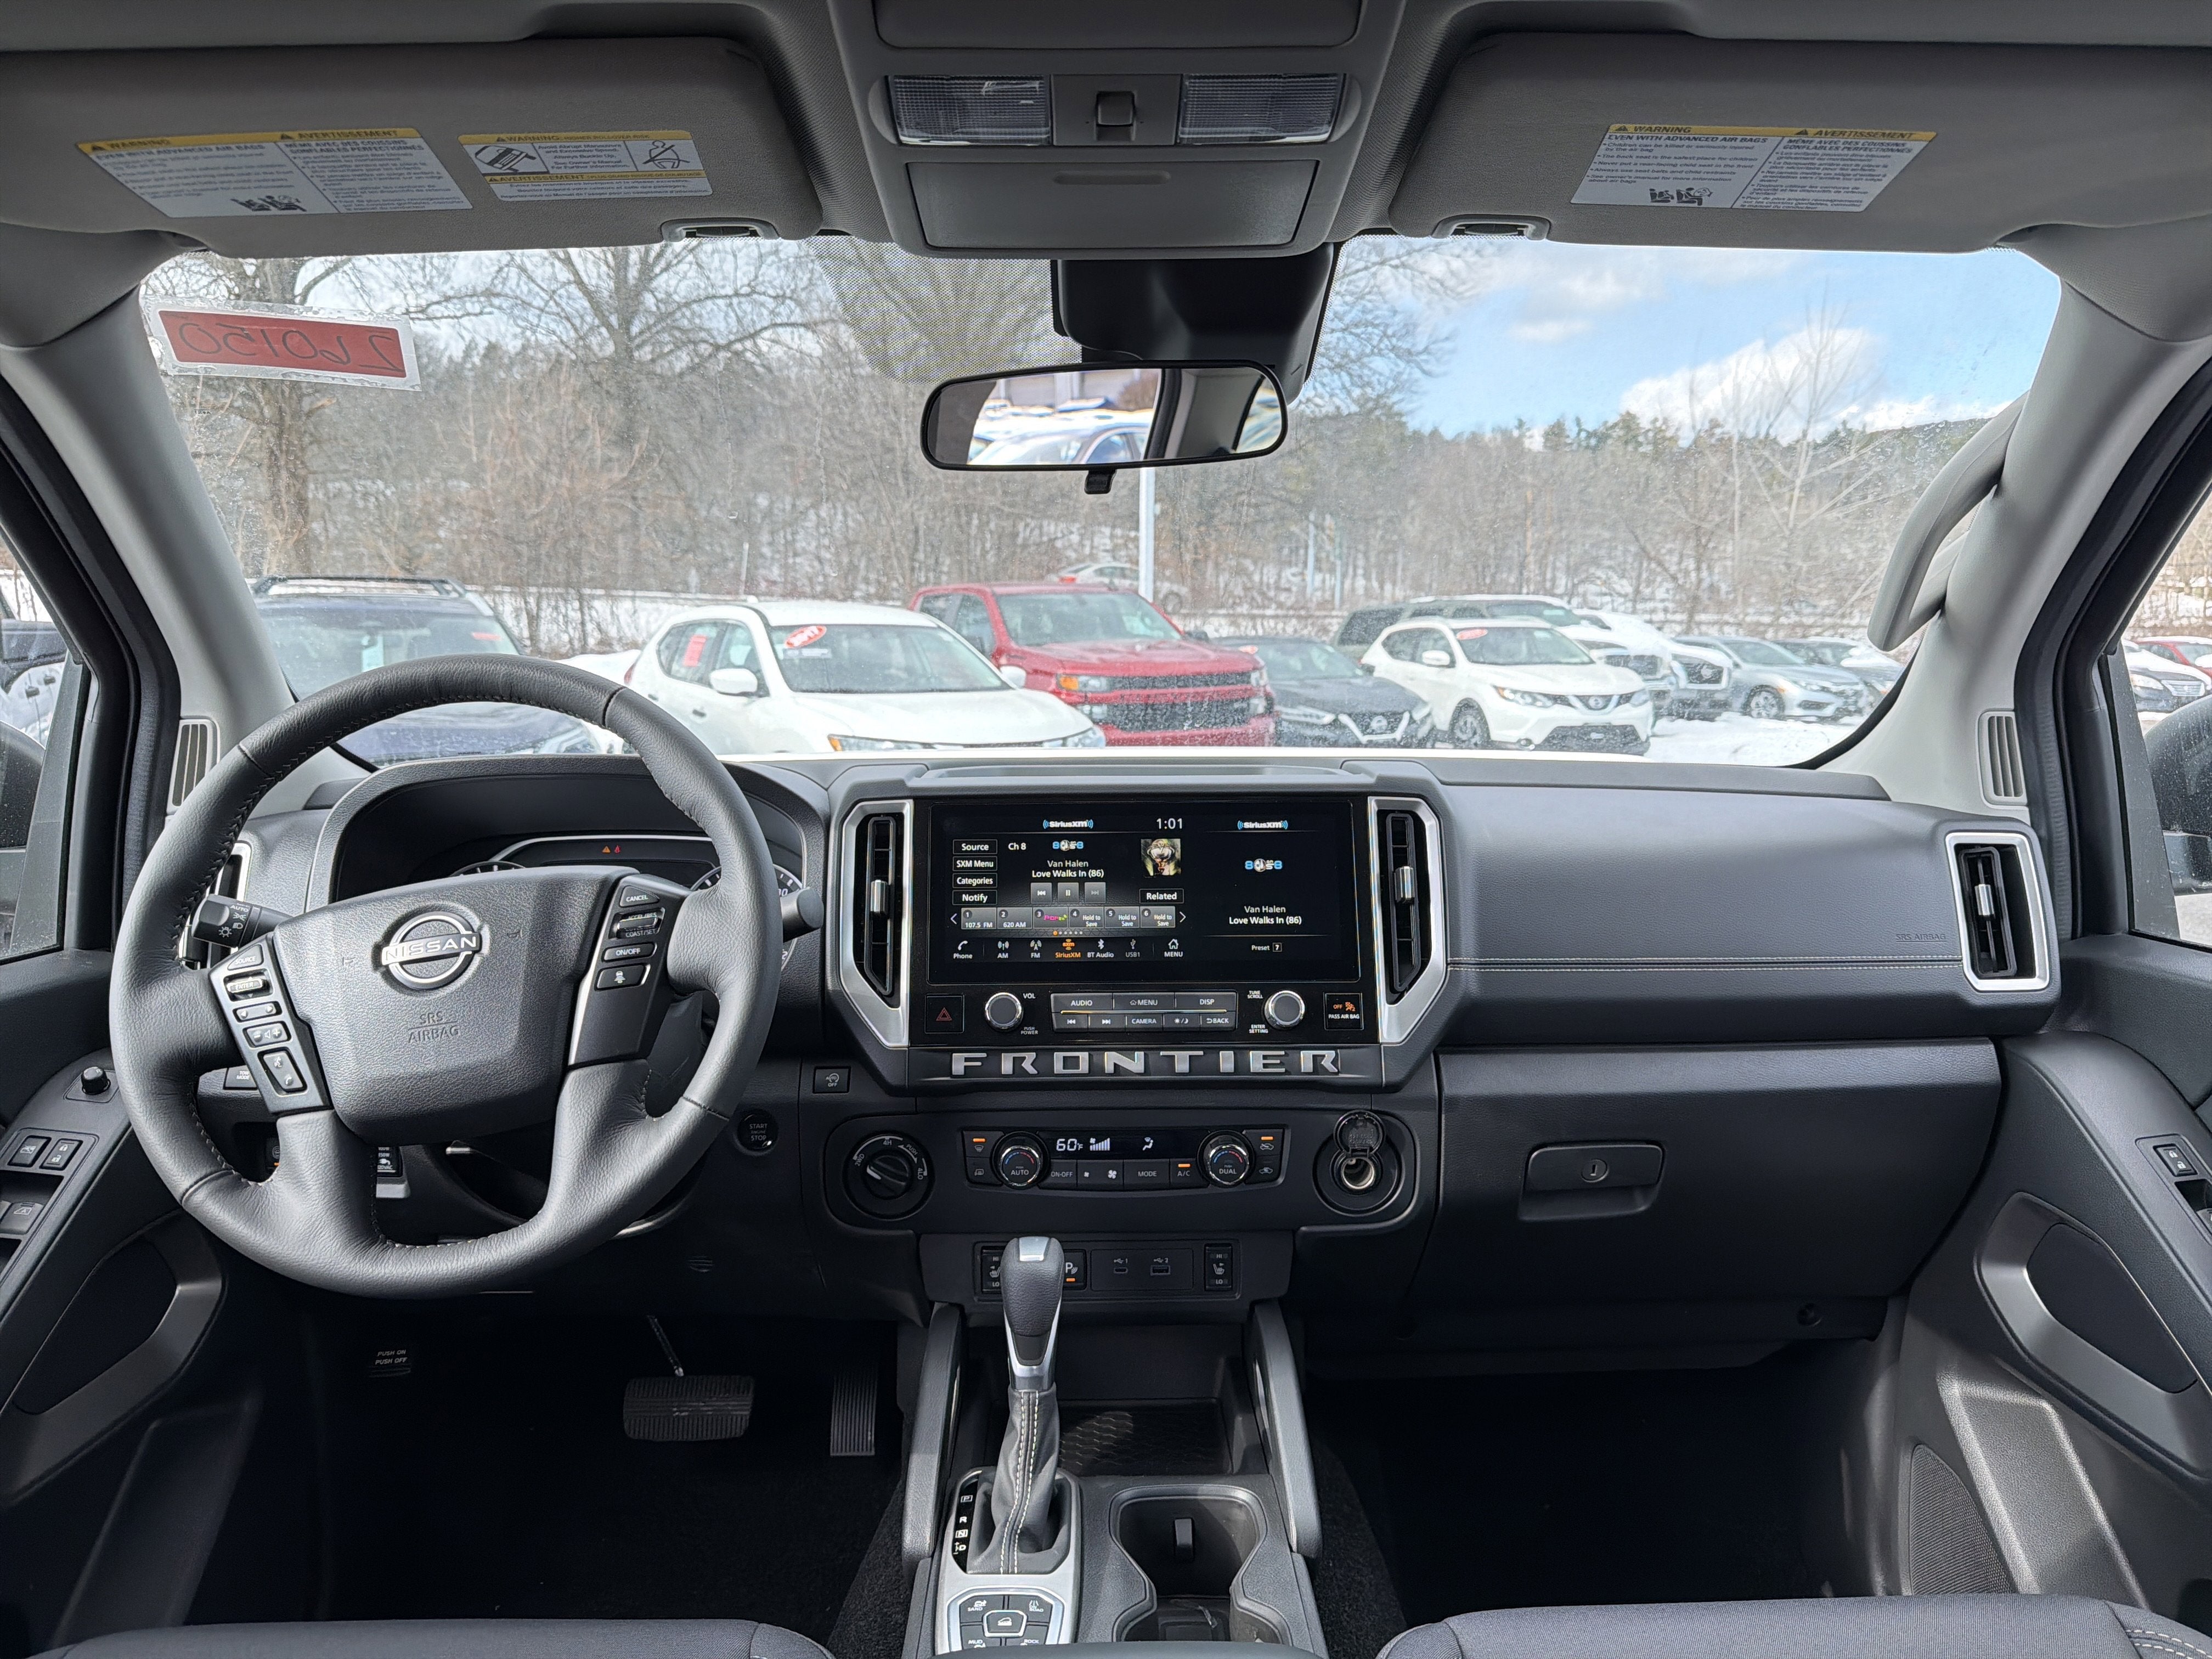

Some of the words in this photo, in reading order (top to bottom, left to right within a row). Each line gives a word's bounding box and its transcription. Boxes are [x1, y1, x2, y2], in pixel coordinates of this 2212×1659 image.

[298, 131, 398, 139] AVERTISSEMENT
[1814, 130, 1915, 138] AVERTISSEMENT
[1157, 817, 1183, 829] 1:01
[1088, 869, 1104, 878] (86)
[957, 878, 993, 886] Categories
[962, 894, 988, 903] Notify
[1286, 916, 1302, 925] (86)
[626, 929, 656, 938] COAST/SET
[386, 936, 476, 961] NISSAN
[235, 956, 256, 964] SOURCE
[420, 1011, 444, 1025] SRS
[408, 1025, 459, 1043] AIRBAG
[952, 1051, 1339, 1075] FRONTIER
[906, 1144, 918, 1155] PUSH
[855, 1153, 865, 1166] 2WD
